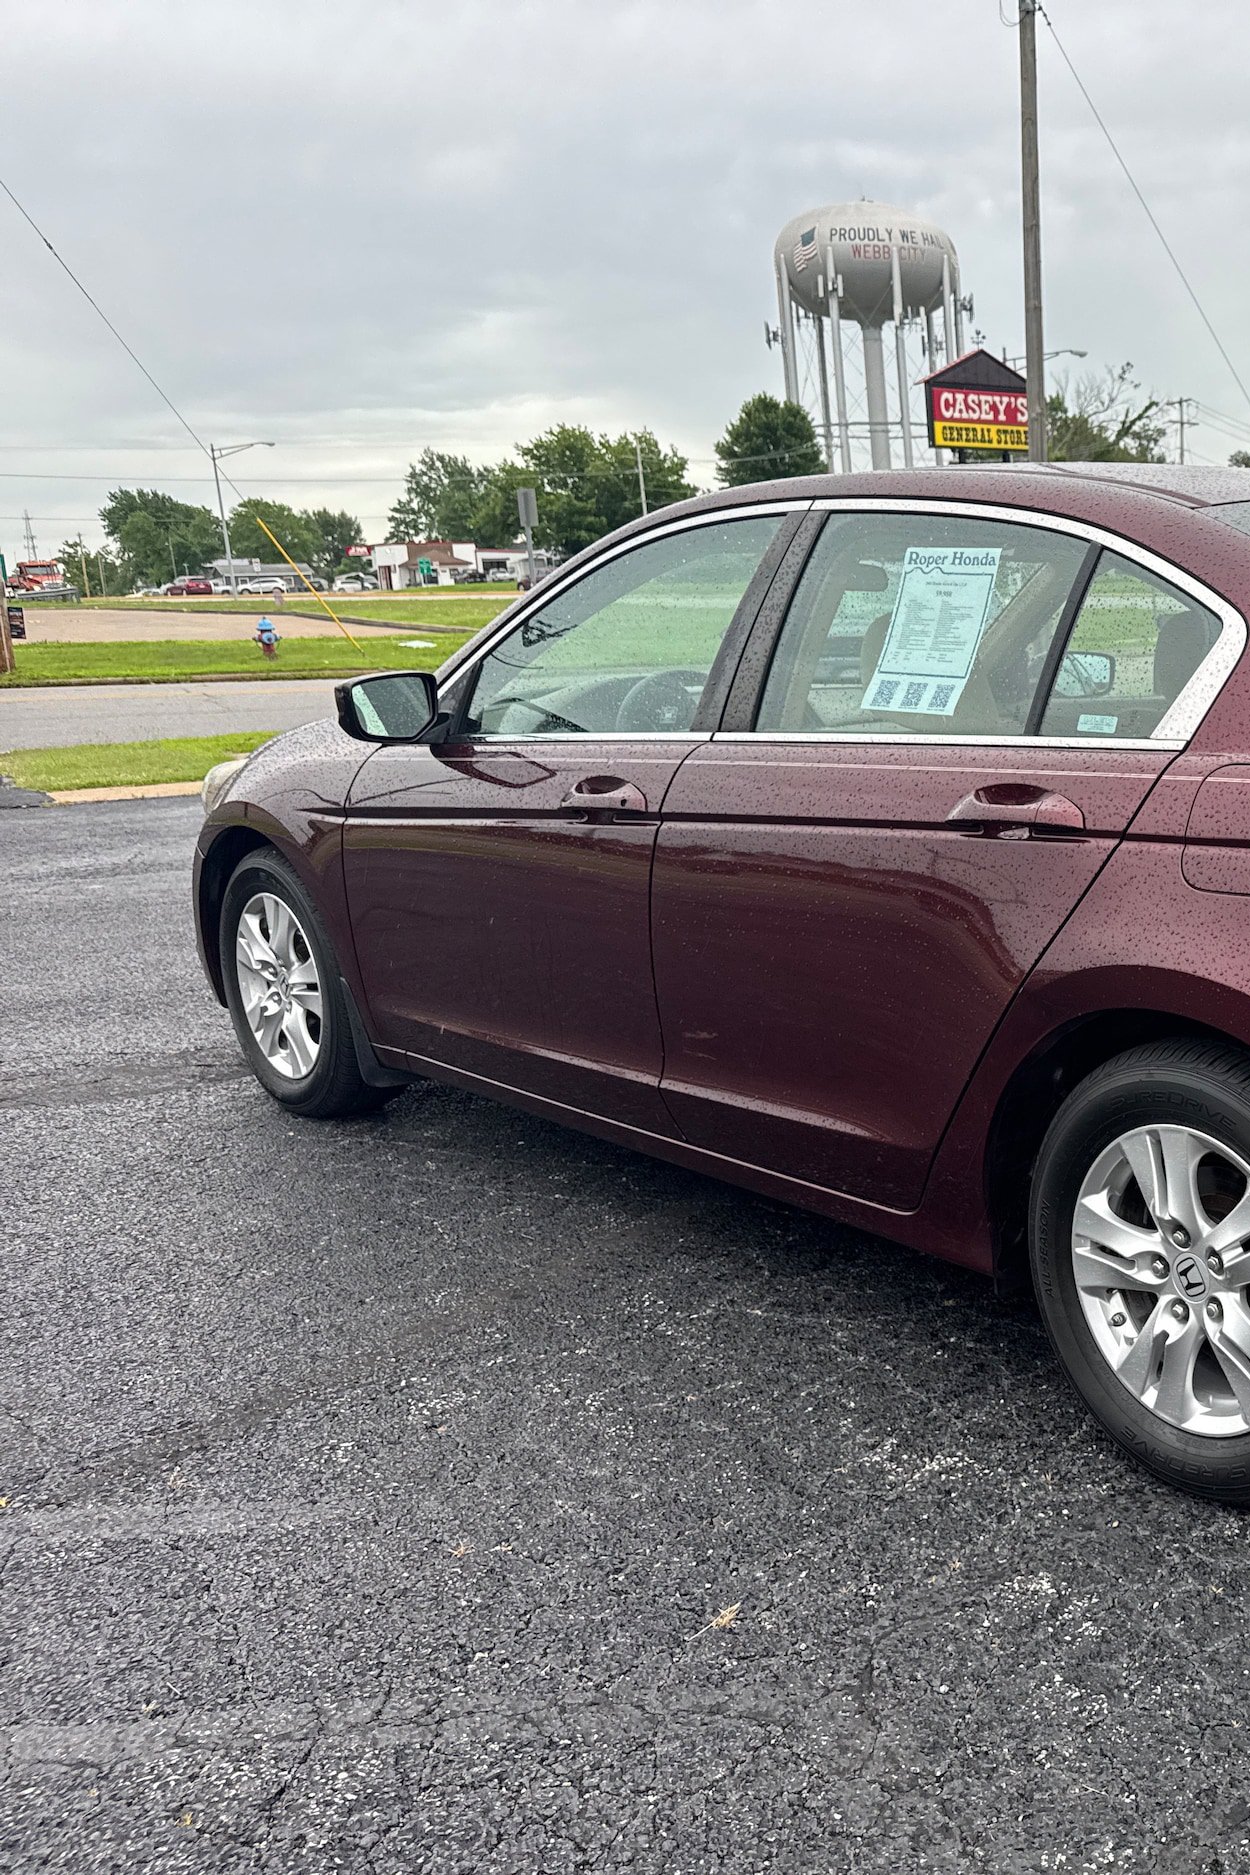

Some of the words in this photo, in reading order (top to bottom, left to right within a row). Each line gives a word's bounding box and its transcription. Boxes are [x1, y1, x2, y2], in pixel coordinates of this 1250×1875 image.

[829, 227, 893, 243] PROUDLY
[899, 229, 919, 244] WE
[851, 244, 892, 261] WEBB
[899, 246, 926, 261] CITY
[940, 391, 1029, 422] CASEY'S
[942, 425, 993, 444] GENERAL
[907, 551, 948, 568] Roper
[950, 551, 996, 567] Honda
[1110, 1088, 1238, 1132] SUREDRIVE
